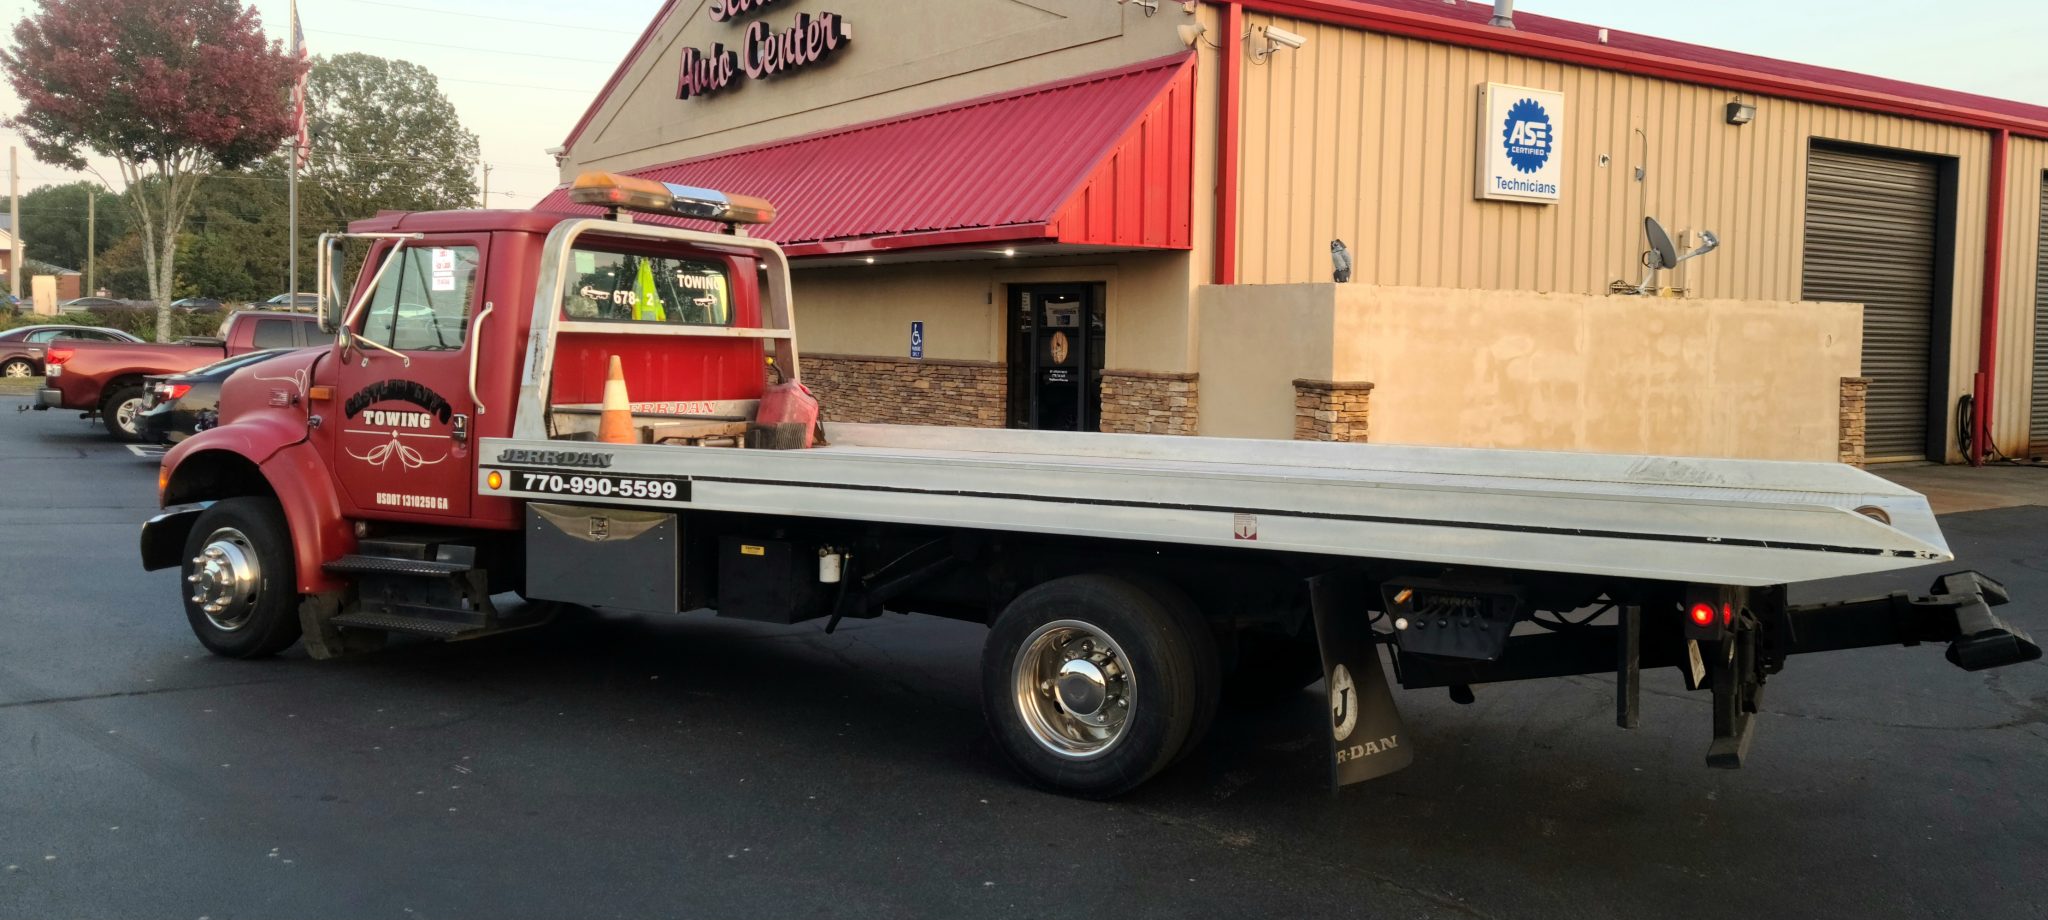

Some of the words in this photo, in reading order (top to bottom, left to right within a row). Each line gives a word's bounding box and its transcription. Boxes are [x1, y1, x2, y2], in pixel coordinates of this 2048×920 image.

[676, 42, 736, 100] Auto
[744, 11, 840, 80] Center
[1508, 120, 1547, 147] ASE
[1511, 146, 1545, 156] CERTIFIED
[1495, 176, 1556, 194] Technicians
[363, 410, 431, 428] TOWING
[523, 473, 677, 499] 770-990-5599
[376, 492, 401, 506] USDOT
[402, 494, 436, 509] 1310250
[437, 497, 449, 510] GA
[1333, 687, 1350, 728] J
[1336, 735, 1399, 764] R-DAN
